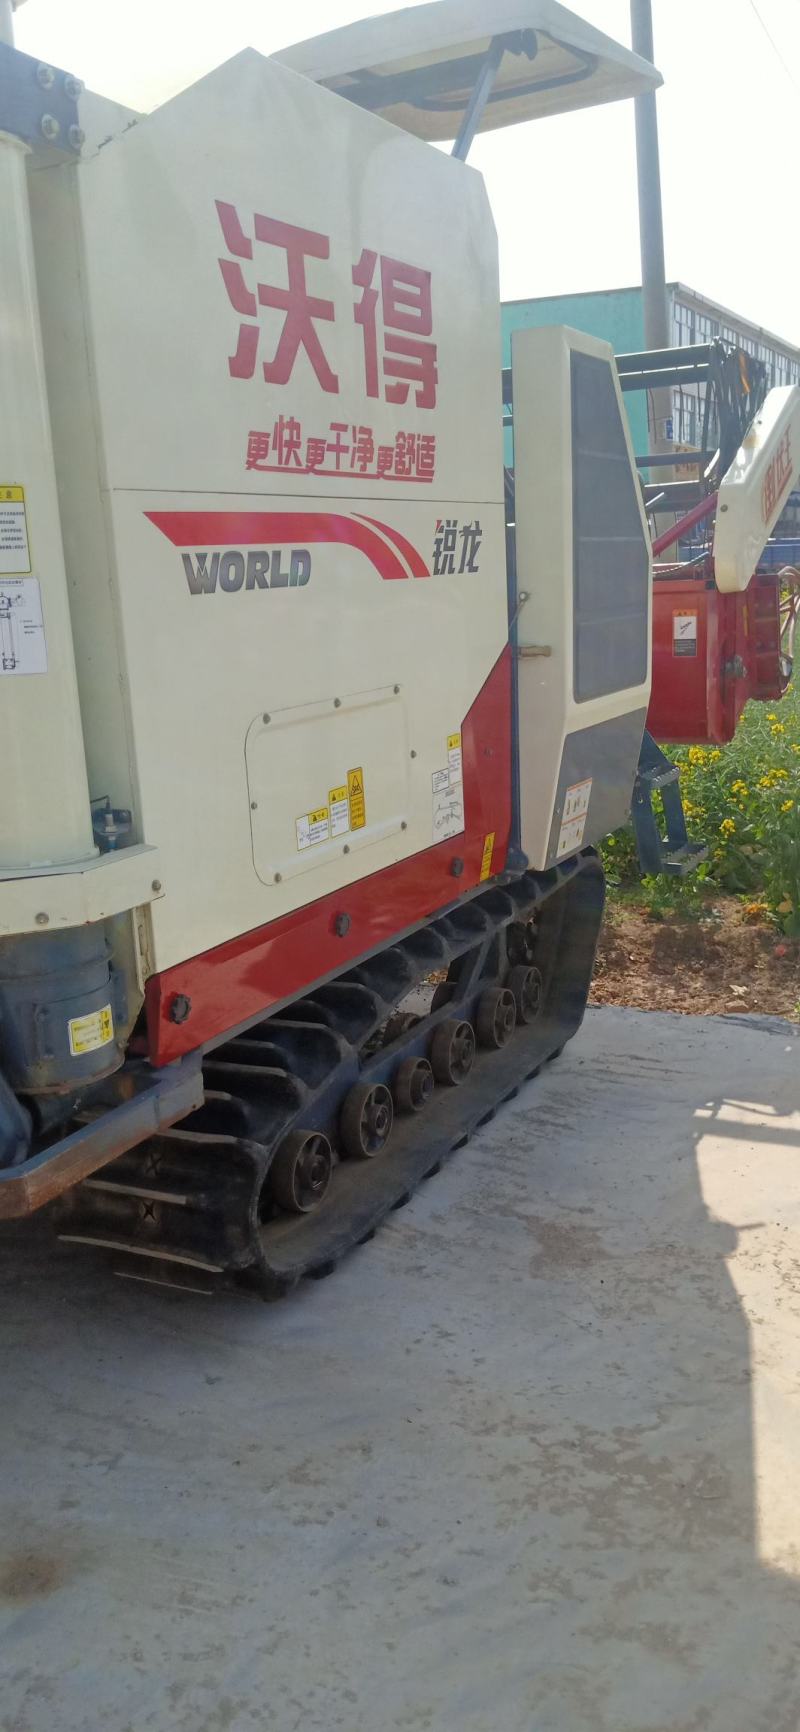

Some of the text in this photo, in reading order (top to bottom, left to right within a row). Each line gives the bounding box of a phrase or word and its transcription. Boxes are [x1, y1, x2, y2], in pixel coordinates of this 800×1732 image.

[214, 199, 438, 410] 沃得
[245, 414, 436, 483] 更快更干净更舒适
[181, 549, 312, 596] WORLD
[432, 519, 483, 576] 锐龙
